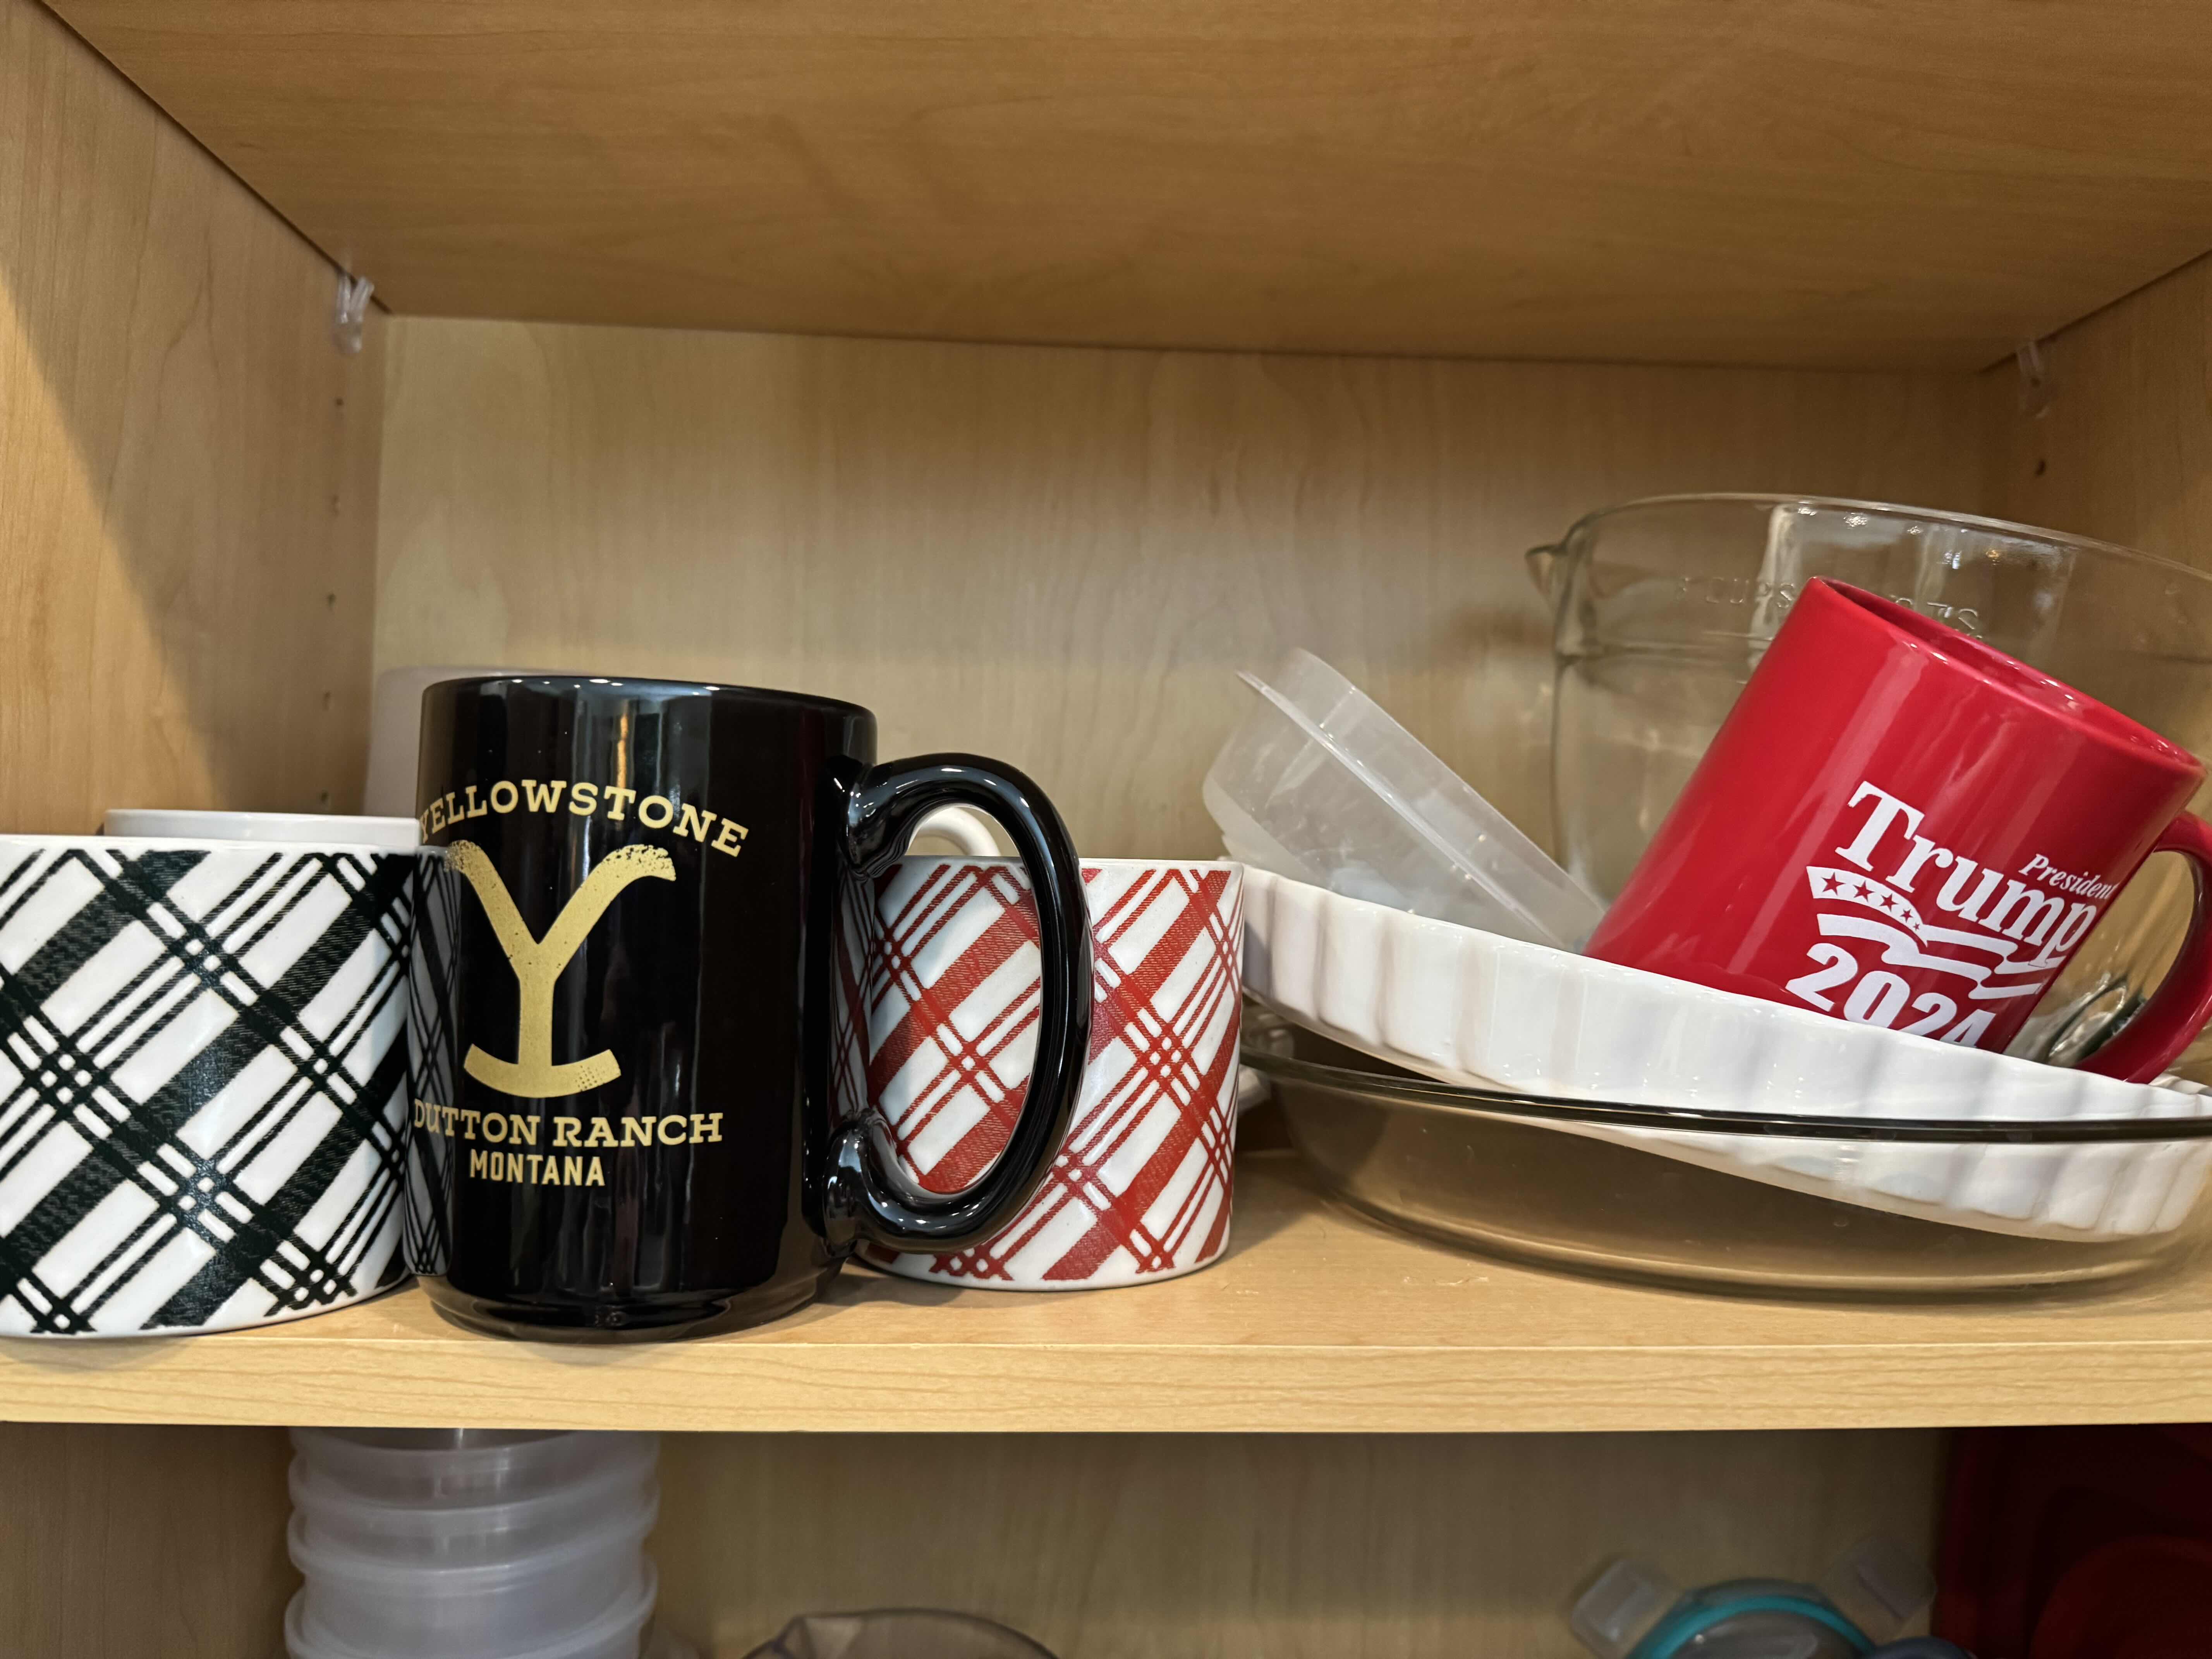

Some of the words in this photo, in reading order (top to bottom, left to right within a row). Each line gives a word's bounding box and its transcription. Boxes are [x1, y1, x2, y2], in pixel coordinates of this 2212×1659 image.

[419, 779, 749, 857] YELLOWSTONE
[1835, 781, 2097, 967] Trump
[2018, 853, 2120, 900] President
[1785, 943, 1996, 1046] 2024
[414, 1098, 541, 1146] DUTTON
[553, 1112, 723, 1147] RANCH
[470, 1149, 605, 1186] MONTANA
